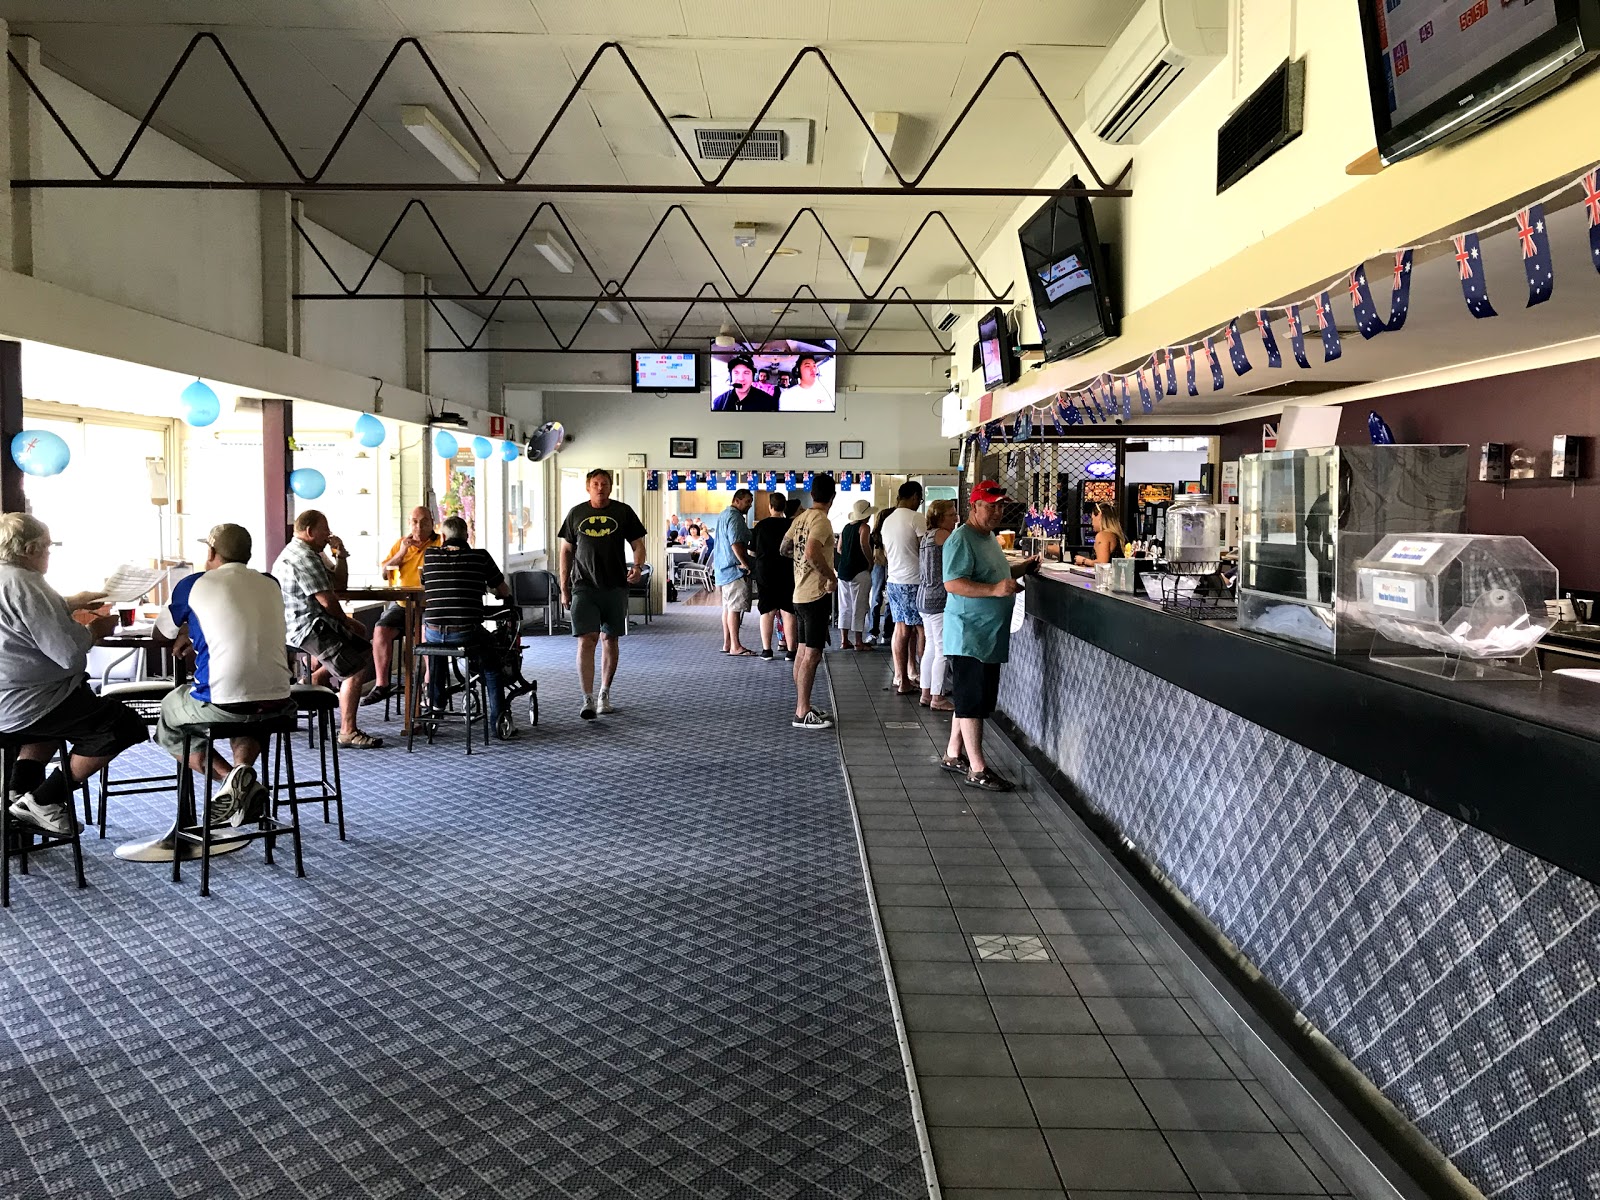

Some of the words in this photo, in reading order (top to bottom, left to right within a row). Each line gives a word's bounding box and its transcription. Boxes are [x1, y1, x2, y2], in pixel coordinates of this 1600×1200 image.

[1460, 9, 1473, 30] 56
[1474, 0, 1487, 20] 57
[1420, 22, 1433, 42] 43
[1395, 41, 1407, 59] 41
[1397, 56, 1409, 75] 51
